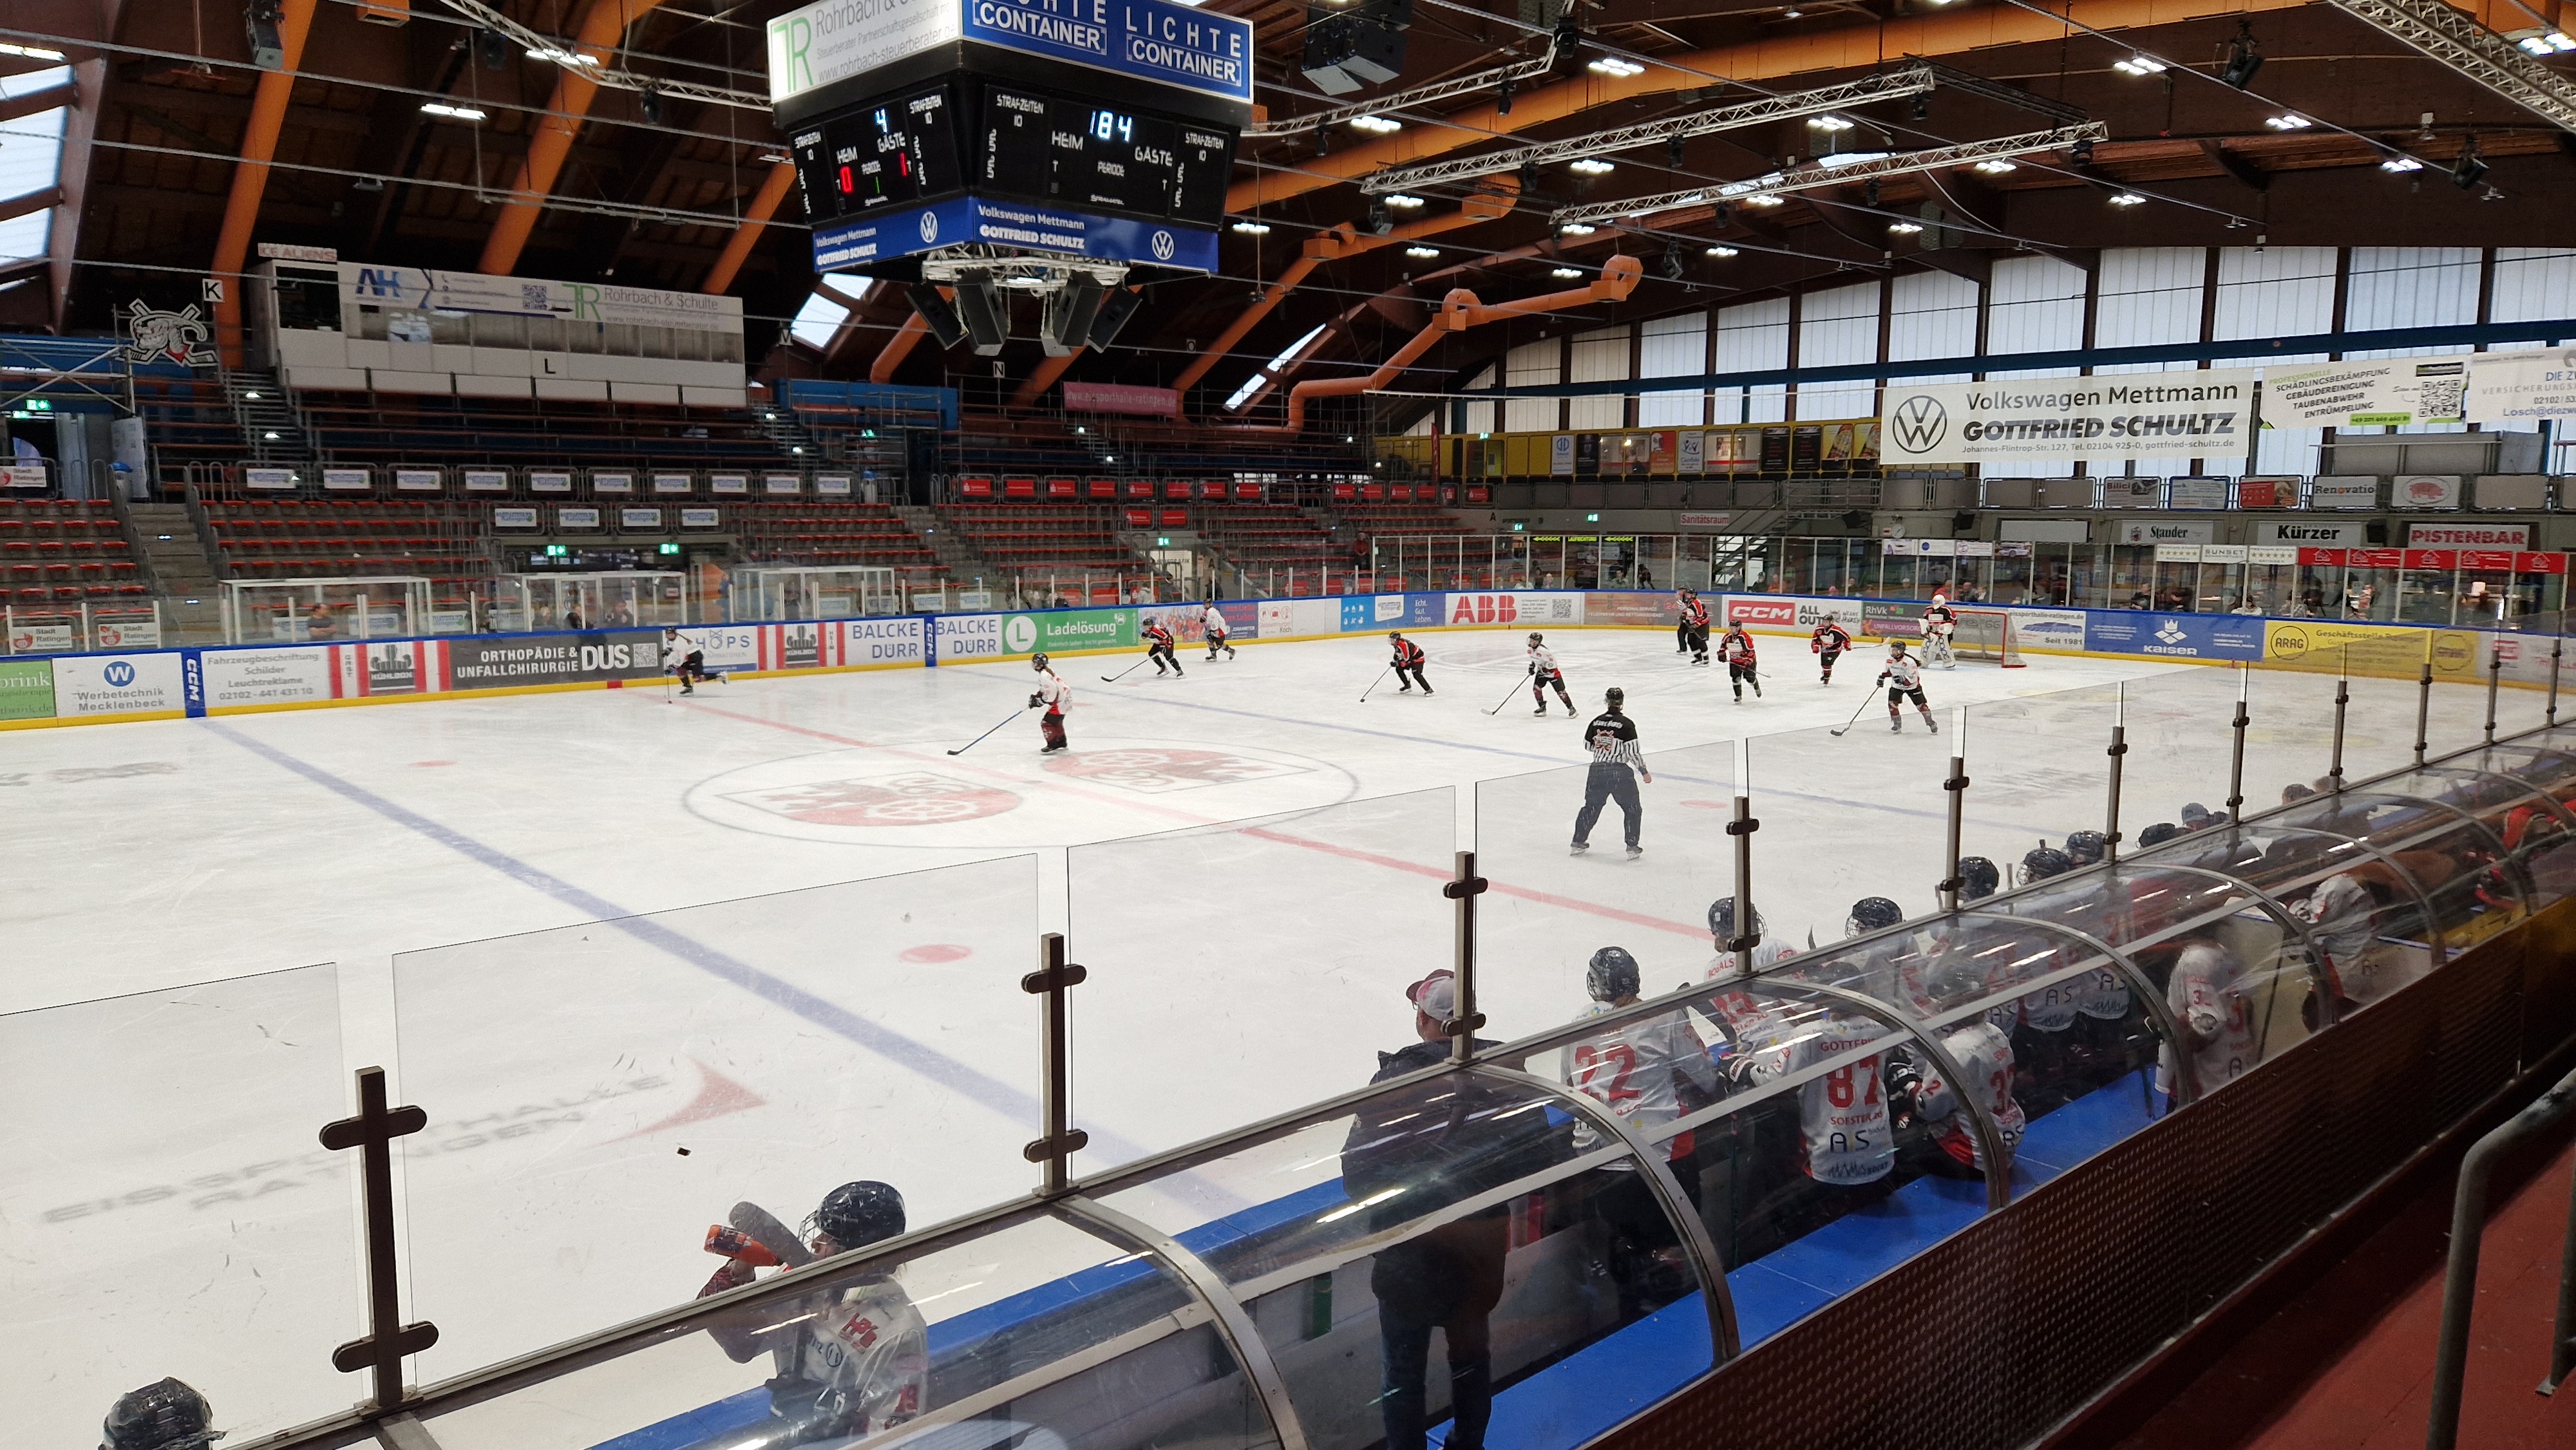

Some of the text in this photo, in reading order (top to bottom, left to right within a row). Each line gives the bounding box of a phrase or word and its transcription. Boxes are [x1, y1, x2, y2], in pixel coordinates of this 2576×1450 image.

[815, 0, 881, 37] Rohrbach
[980, 3, 1101, 51] CONTAINER
[1126, 6, 1242, 59] LICHTE
[817, 37, 857, 60] Steuerberater
[1133, 39, 1237, 82] CONTAINER
[996, 95, 1044, 115] STRAFZEITEN
[875, 108, 889, 133] 4
[1014, 115, 1023, 127] 10
[1052, 131, 1083, 151] HEIM
[1185, 133, 1224, 149] STRAFZEITEN
[837, 146, 858, 164] HEIM
[1198, 150, 1206, 161] 10
[1052, 160, 1058, 172] T
[1097, 161, 1124, 176] PERIODE
[840, 165, 853, 193] 0
[1162, 179, 1168, 191] T
[978, 205, 1084, 230] Volkswagen Mettmann
[817, 227, 876, 248] Volkswagen Mettmann
[980, 225, 1085, 249] GOTTFRIED SCHULTZ
[817, 243, 877, 265] GOTTFRIED SCHULTZ
[205, 281, 220, 299] K
[605, 287, 718, 310] Rohrbach & Schulte
[544, 358, 556, 374] L
[994, 364, 1003, 377] N
[2269, 369, 2331, 385] PROFESSIONELLE
[2276, 368, 2391, 392] SCHÄDLINGSBEKÄMPFUNG
[2546, 372, 2562, 381] DIE
[2286, 380, 2374, 400] GEBÄUDEREINIGUNG
[2482, 384, 2576, 395] VERSICHERUNGS
[1965, 385, 2239, 412] Volkswagen Mettmann
[2293, 392, 2365, 410] TAUBENABWEHR
[2534, 396, 2559, 404] 02102
[2304, 402, 2374, 418] ENTRÜMPELUNG
[1963, 412, 2237, 441] GOTTFRIED SCHULTZ
[1962, 439, 2235, 453] Johannes-Flintrop-Str. 127, Tel. 02104 925-0, gottfried-schultz.de
[1681, 515, 1730, 524] Sanitätsraum
[2150, 526, 2188, 540] Stauder
[2277, 525, 2340, 540] Kürzer
[2411, 530, 2525, 545] PISTENBAR
[1452, 596, 1517, 623] ABB
[1732, 606, 1792, 620] CCM
[1799, 605, 1820, 615] ALL
[1866, 606, 1888, 615] RhVk
[2009, 612, 2084, 620] eissporthalle-ratingen.de
[936, 619, 997, 635] BALCKE
[1047, 621, 1116, 636] Ladelösung
[1799, 616, 1823, 625] OUT
[853, 623, 918, 639] BALCKE
[925, 623, 934, 655] CCM
[1016, 623, 1028, 643] L
[872, 643, 918, 659] DÜRR
[954, 639, 997, 654] DÜRR
[2275, 638, 2304, 648] ARAG
[208, 653, 319, 665] Fahrzeugbeschriftung
[481, 646, 578, 663] ORTHOPÄDIE &
[582, 644, 630, 671] DUS
[108, 666, 130, 682] W
[245, 666, 285, 675] Schilder
[457, 661, 578, 678] UNFALLCHIRURGIE
[187, 658, 199, 701] CCM
[228, 677, 303, 688] Leuchtreklame
[78, 688, 164, 701] Werbetechnik
[220, 691, 251, 701] 02102
[79, 699, 165, 711] Mecklenbeck
[1575, 1044, 1642, 1102] 22
[1826, 1056, 1880, 1109] 87
[41, 1075, 670, 1223] EISSPHALLE
